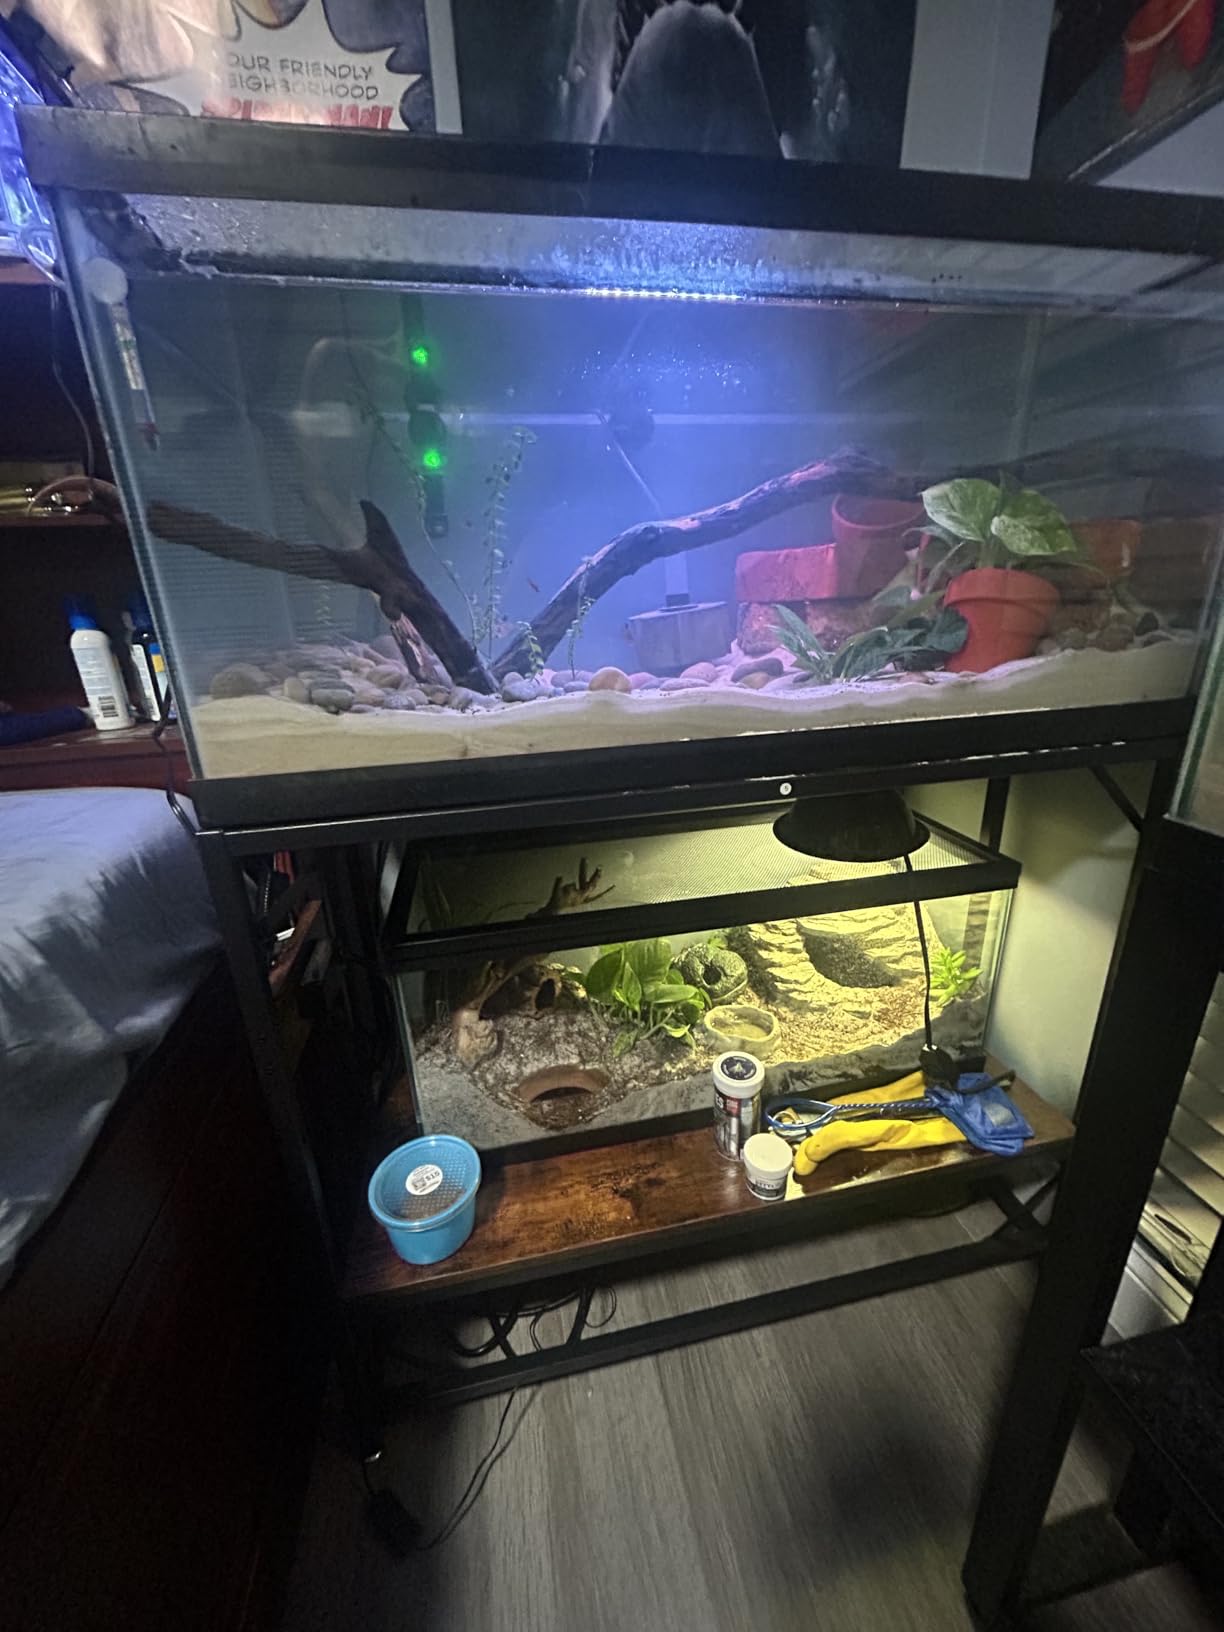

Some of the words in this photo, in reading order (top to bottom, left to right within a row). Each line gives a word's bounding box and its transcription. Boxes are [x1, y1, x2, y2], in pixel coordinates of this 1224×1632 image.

[226, 53, 271, 73] OUR
[279, 57, 373, 81] FRIENDLY
[227, 74, 379, 100] EIGHBORHOOD
